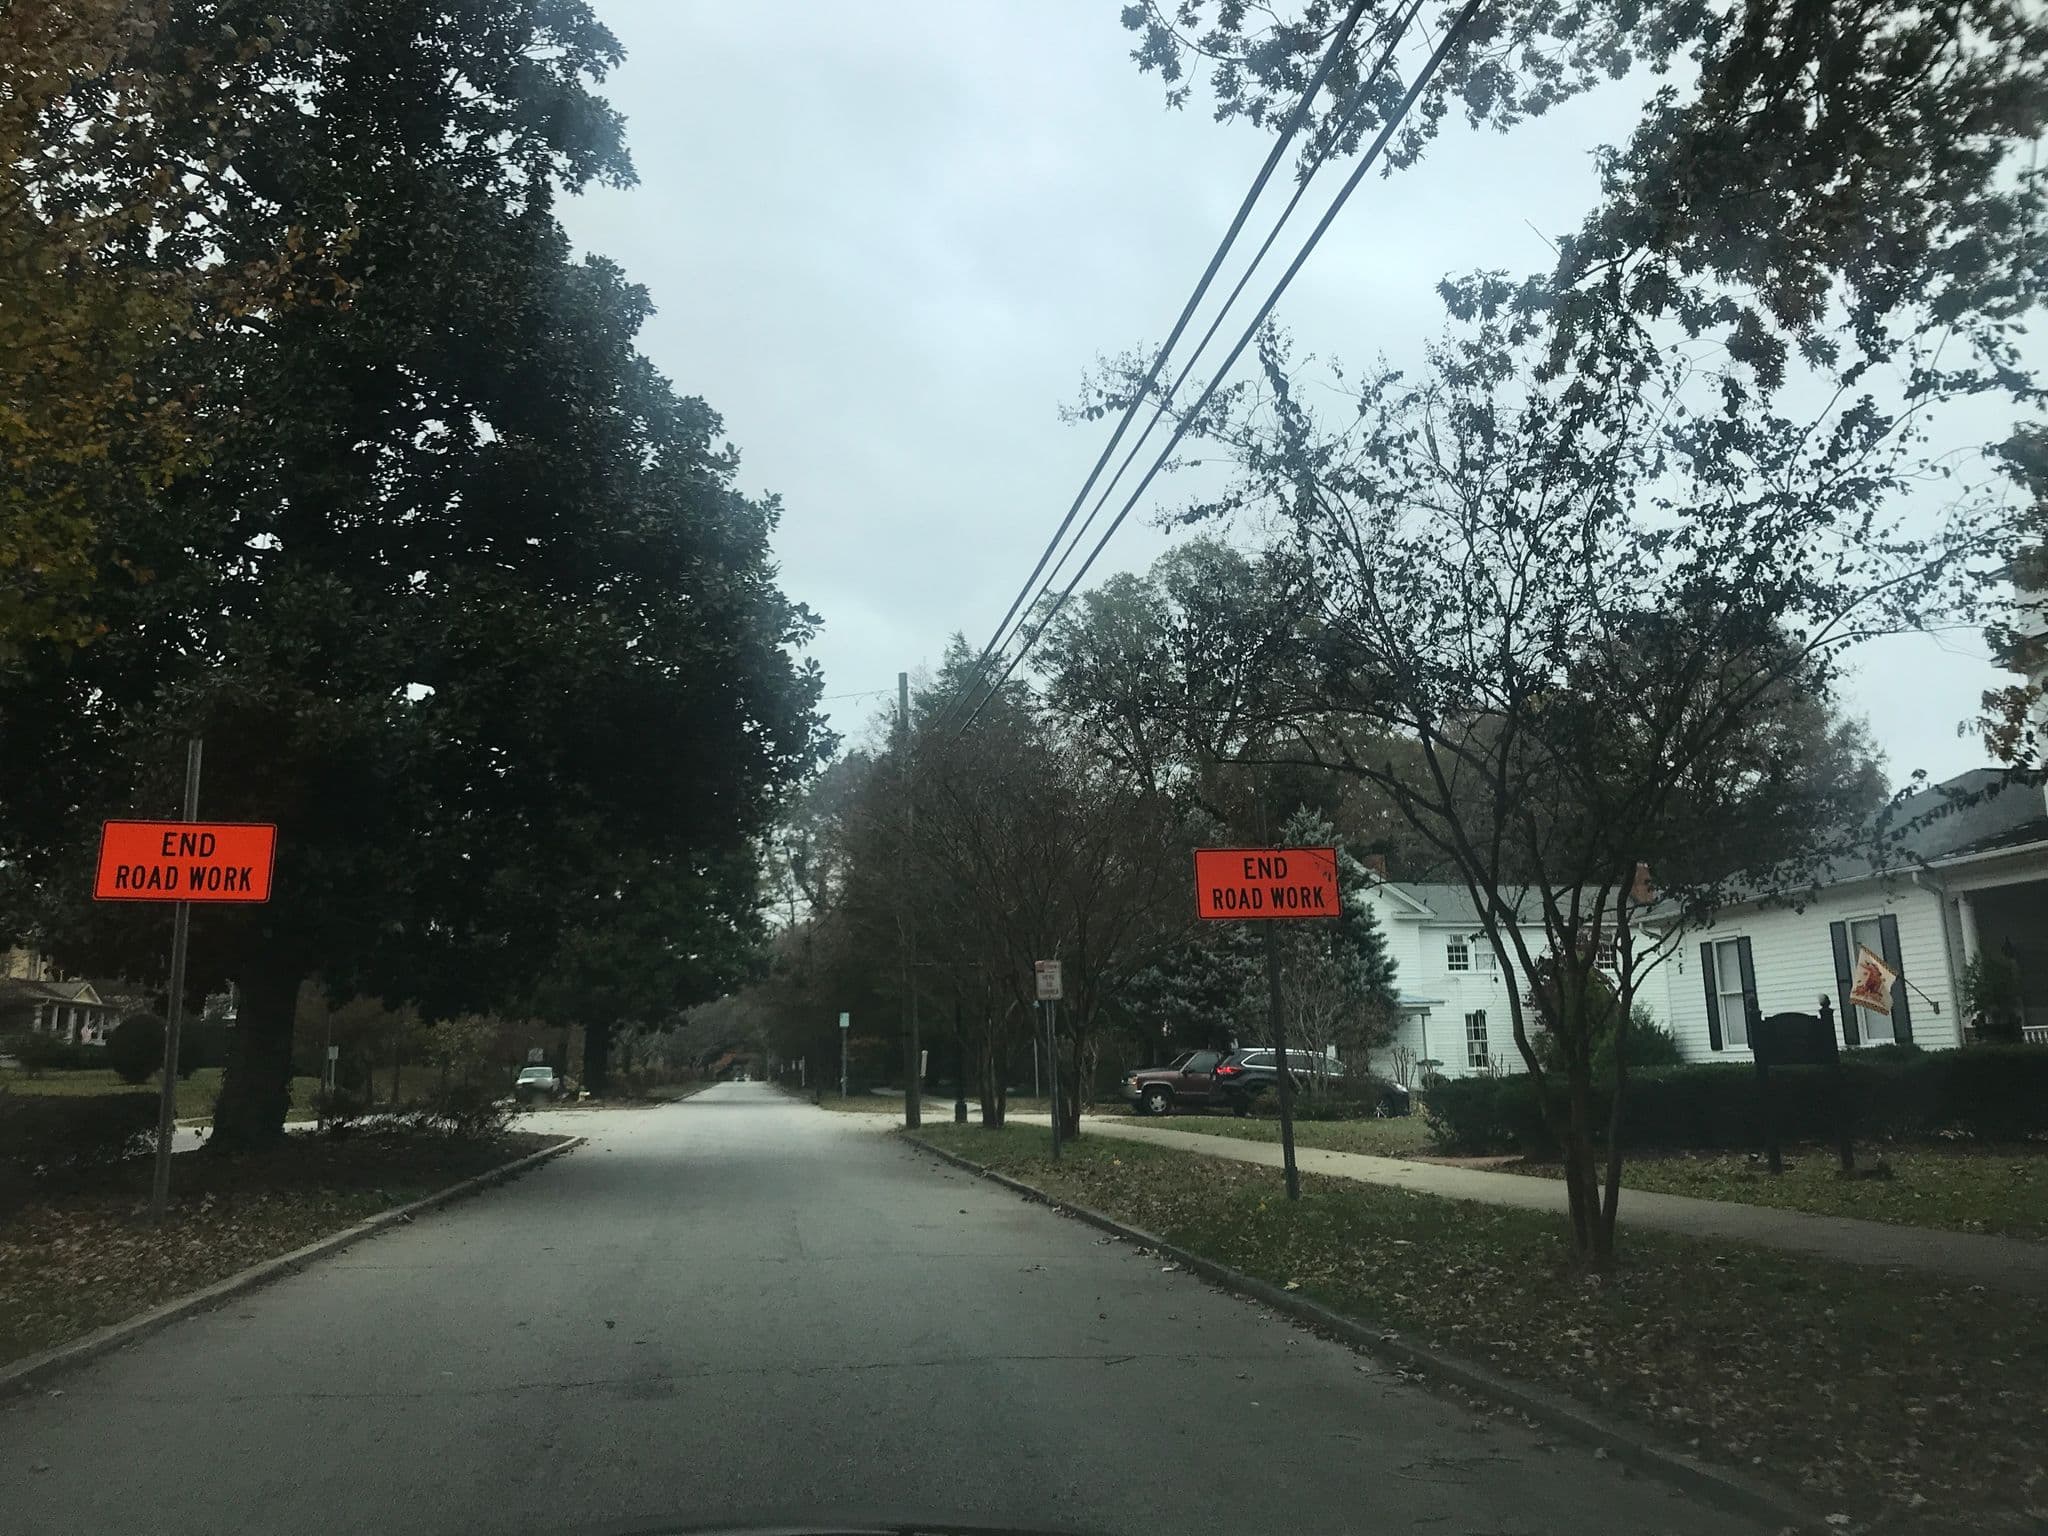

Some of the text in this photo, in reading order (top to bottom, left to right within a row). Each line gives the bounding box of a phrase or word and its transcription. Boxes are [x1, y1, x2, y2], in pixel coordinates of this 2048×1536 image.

[161, 831, 216, 858] END
[115, 865, 253, 891] ROAD WORK
[1243, 857, 1288, 880] END
[1212, 886, 1325, 910] ROAD WORK
